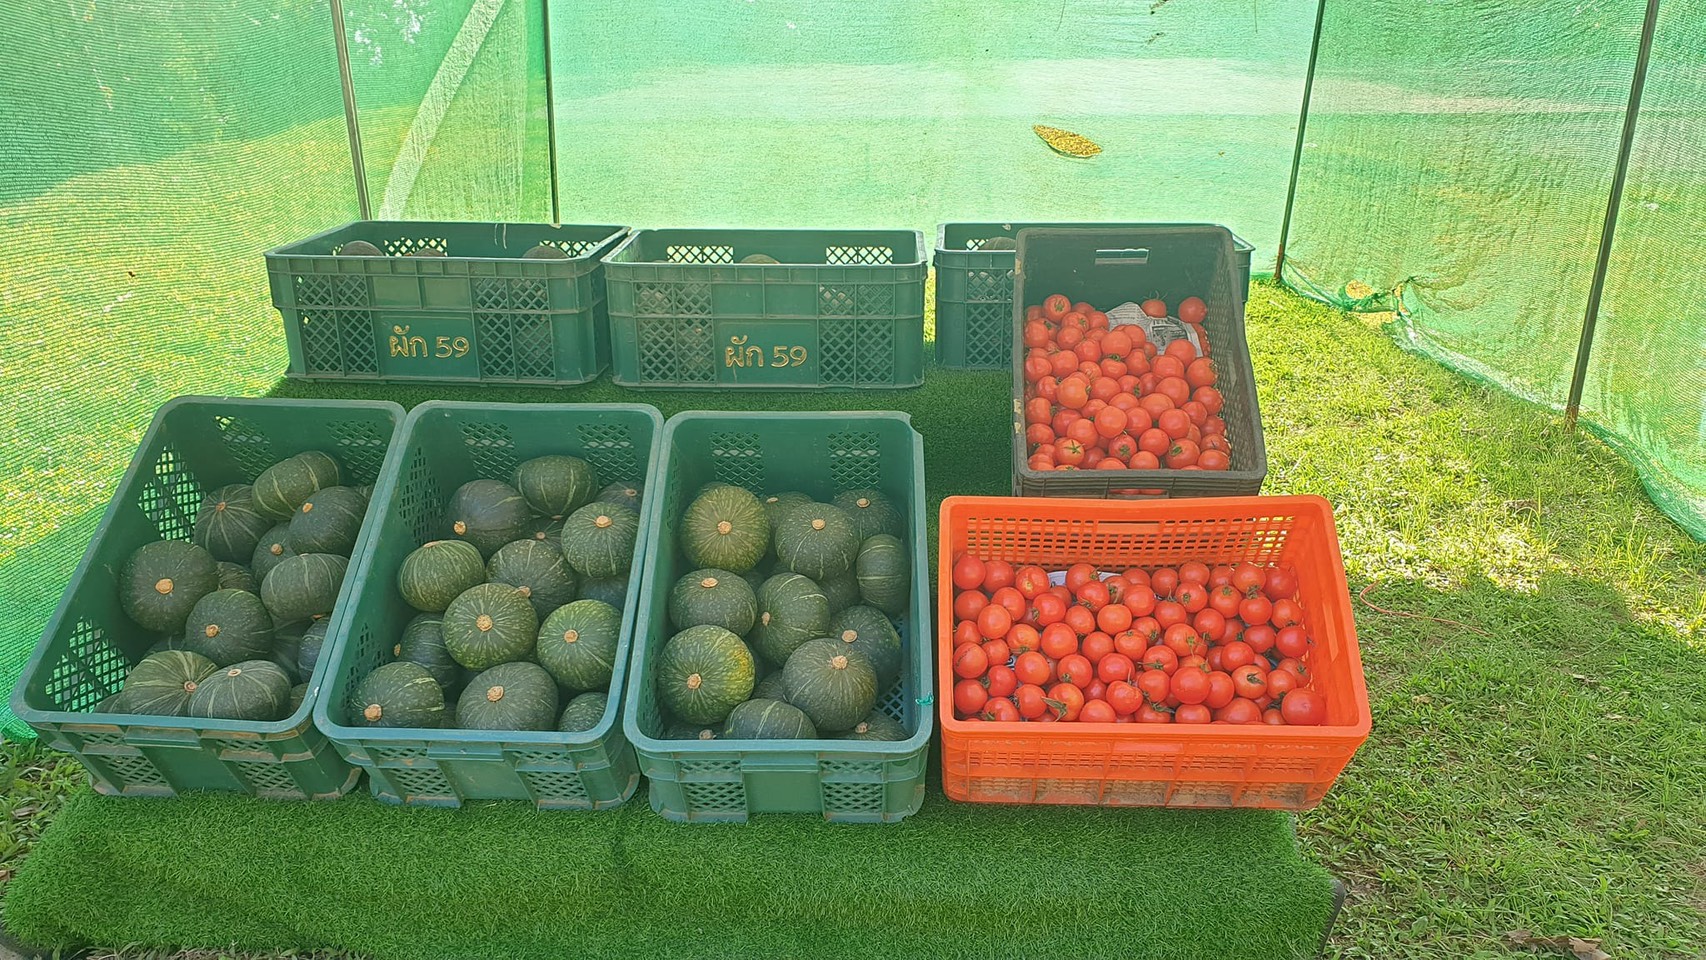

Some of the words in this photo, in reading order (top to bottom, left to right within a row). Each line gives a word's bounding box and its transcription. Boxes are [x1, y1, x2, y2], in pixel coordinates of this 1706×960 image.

[389, 325, 428, 357] ผัก
[435, 336, 470, 358] 59
[725, 335, 764, 368] ผัก
[770, 345, 808, 368] 59
